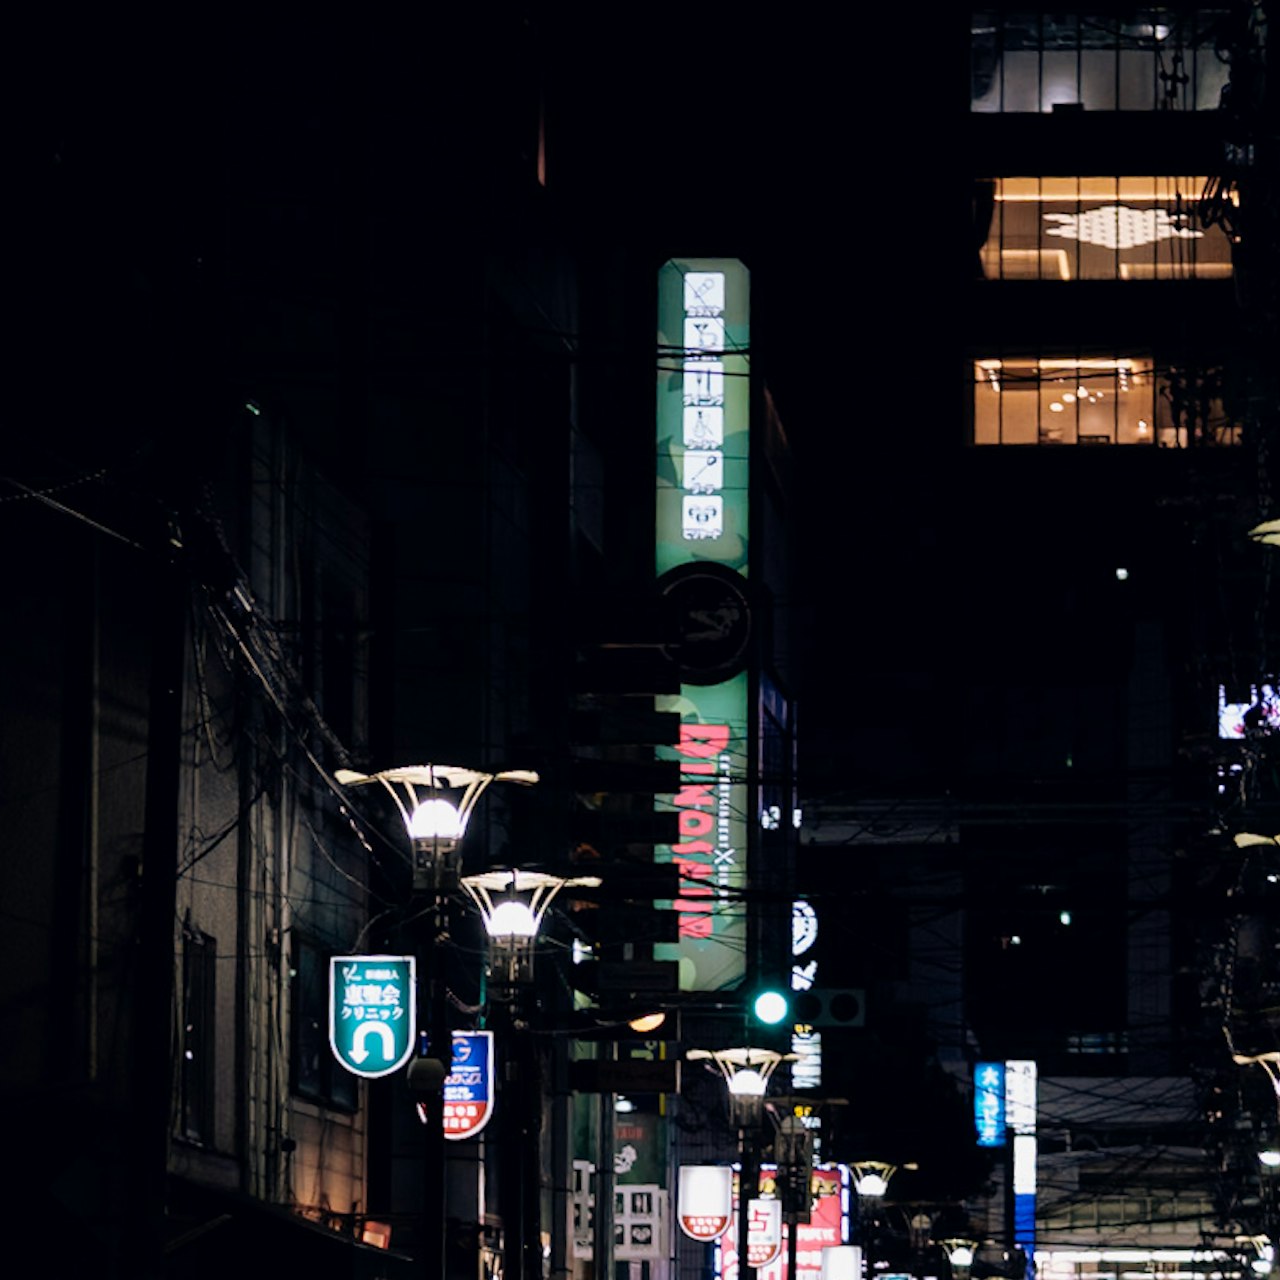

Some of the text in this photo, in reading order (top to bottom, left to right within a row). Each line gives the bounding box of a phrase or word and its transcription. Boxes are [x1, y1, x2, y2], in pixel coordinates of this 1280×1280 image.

[341, 1007, 404, 1021] クリニック
